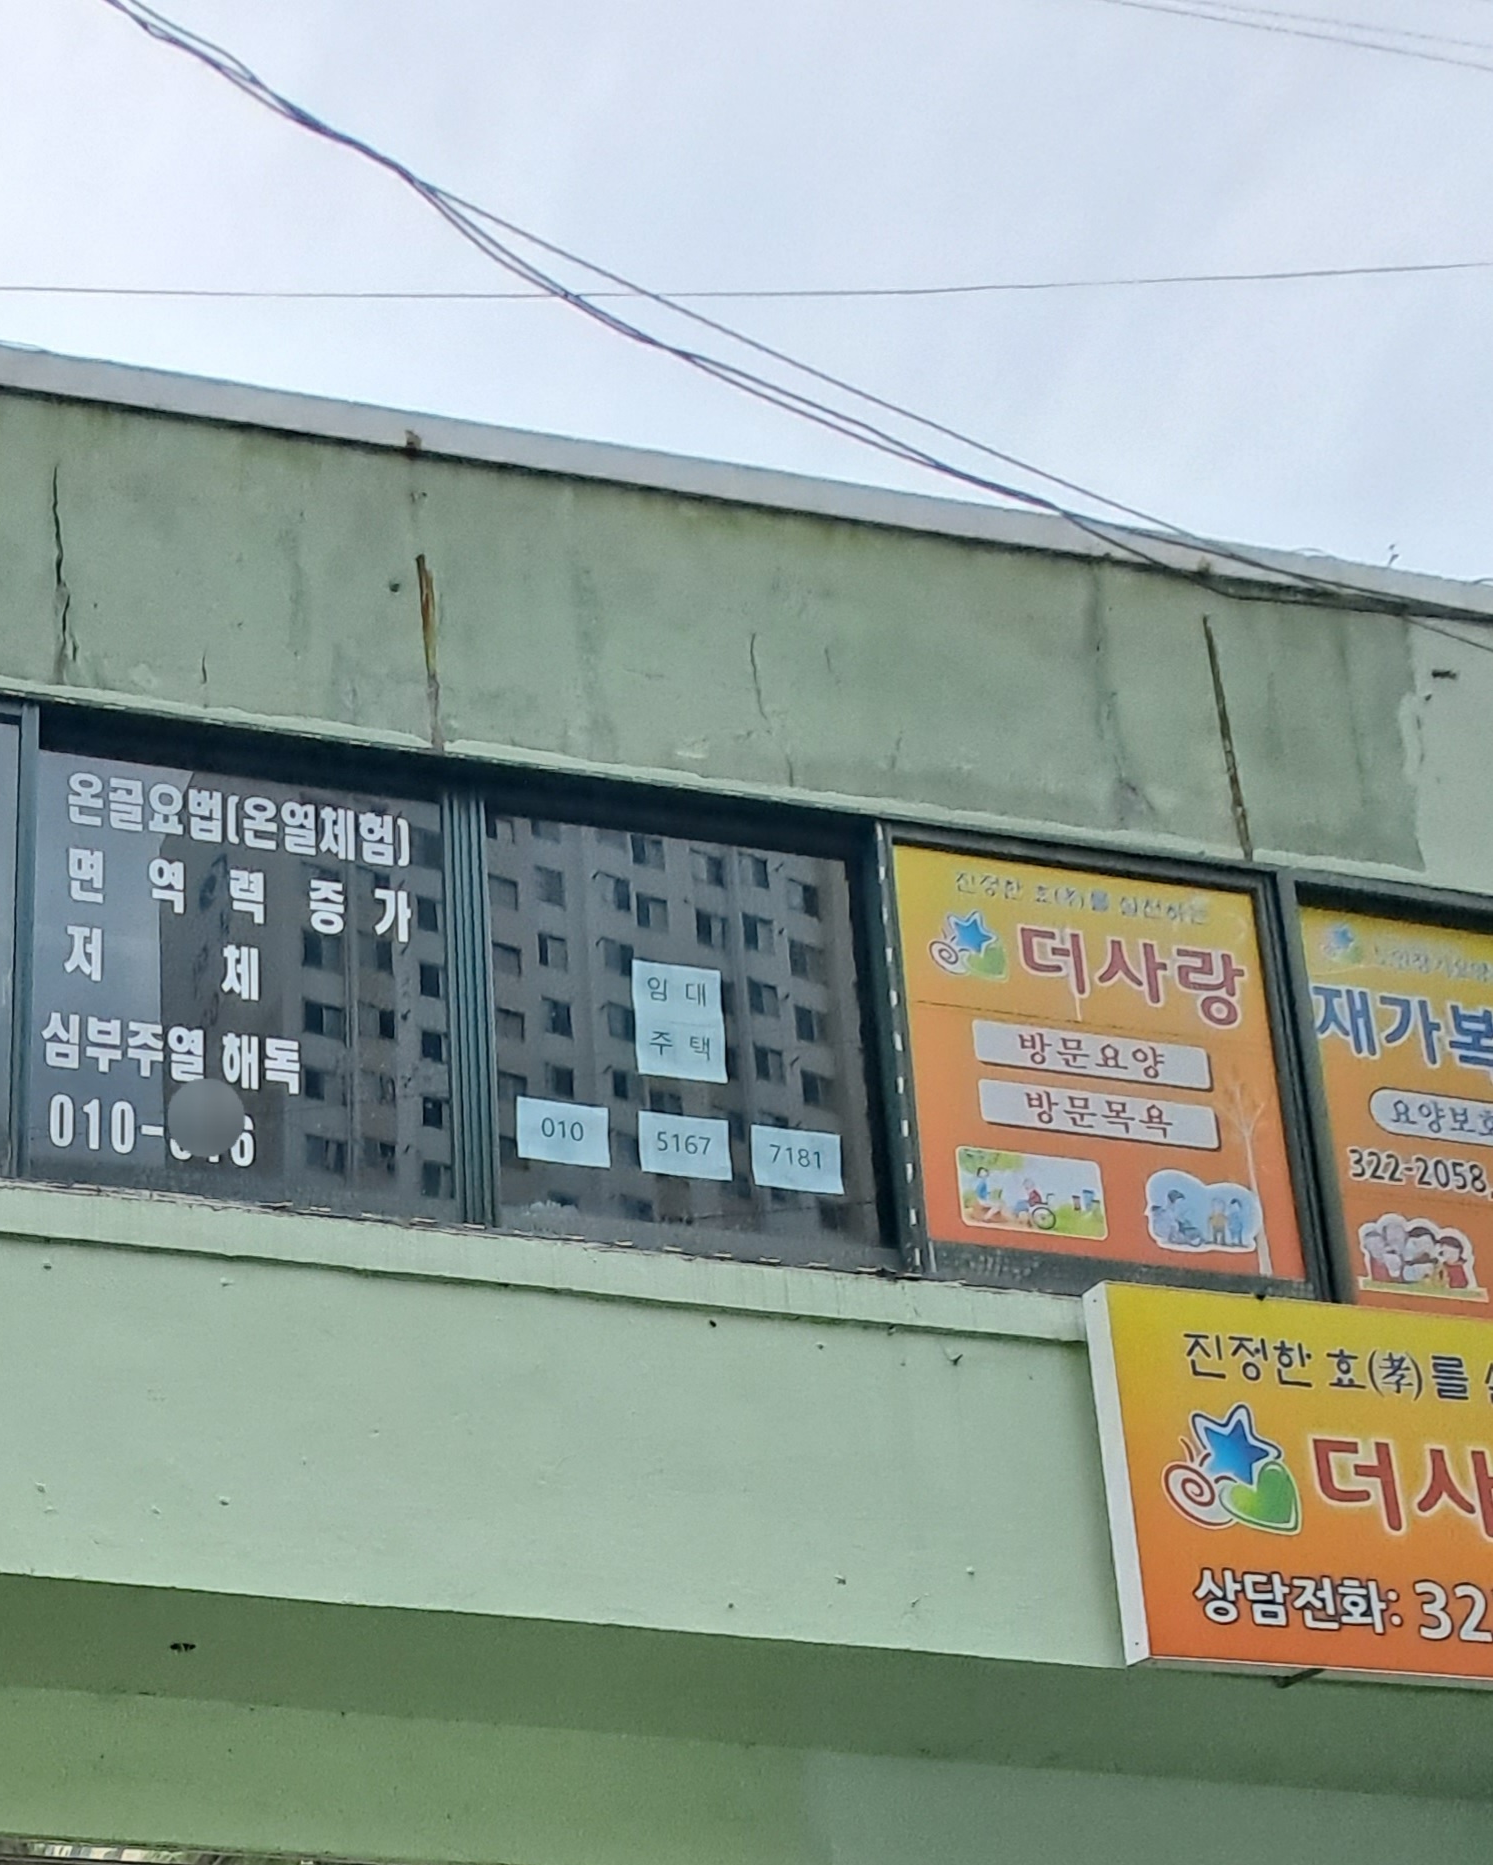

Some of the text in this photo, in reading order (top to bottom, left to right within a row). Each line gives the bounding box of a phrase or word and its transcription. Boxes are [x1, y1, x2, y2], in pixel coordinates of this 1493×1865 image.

[67, 772, 411, 868] 온골요법(온열체험)
[1017, 924, 1247, 1029] 더사랑
[41, 1011, 302, 1096] 심부주열 해독
[1018, 1032, 1167, 1081] 방문요양
[541, 1116, 585, 1143] 010
[656, 1130, 712, 1157] 5167
[1024, 1090, 1174, 1139] 방문목욕
[769, 1143, 823, 1170] 7181
[1183, 1332, 1314, 1389] 진정한
[1327, 1347, 1471, 1402] 효(孝)를
[1194, 1566, 1404, 1636] 상담전화:
